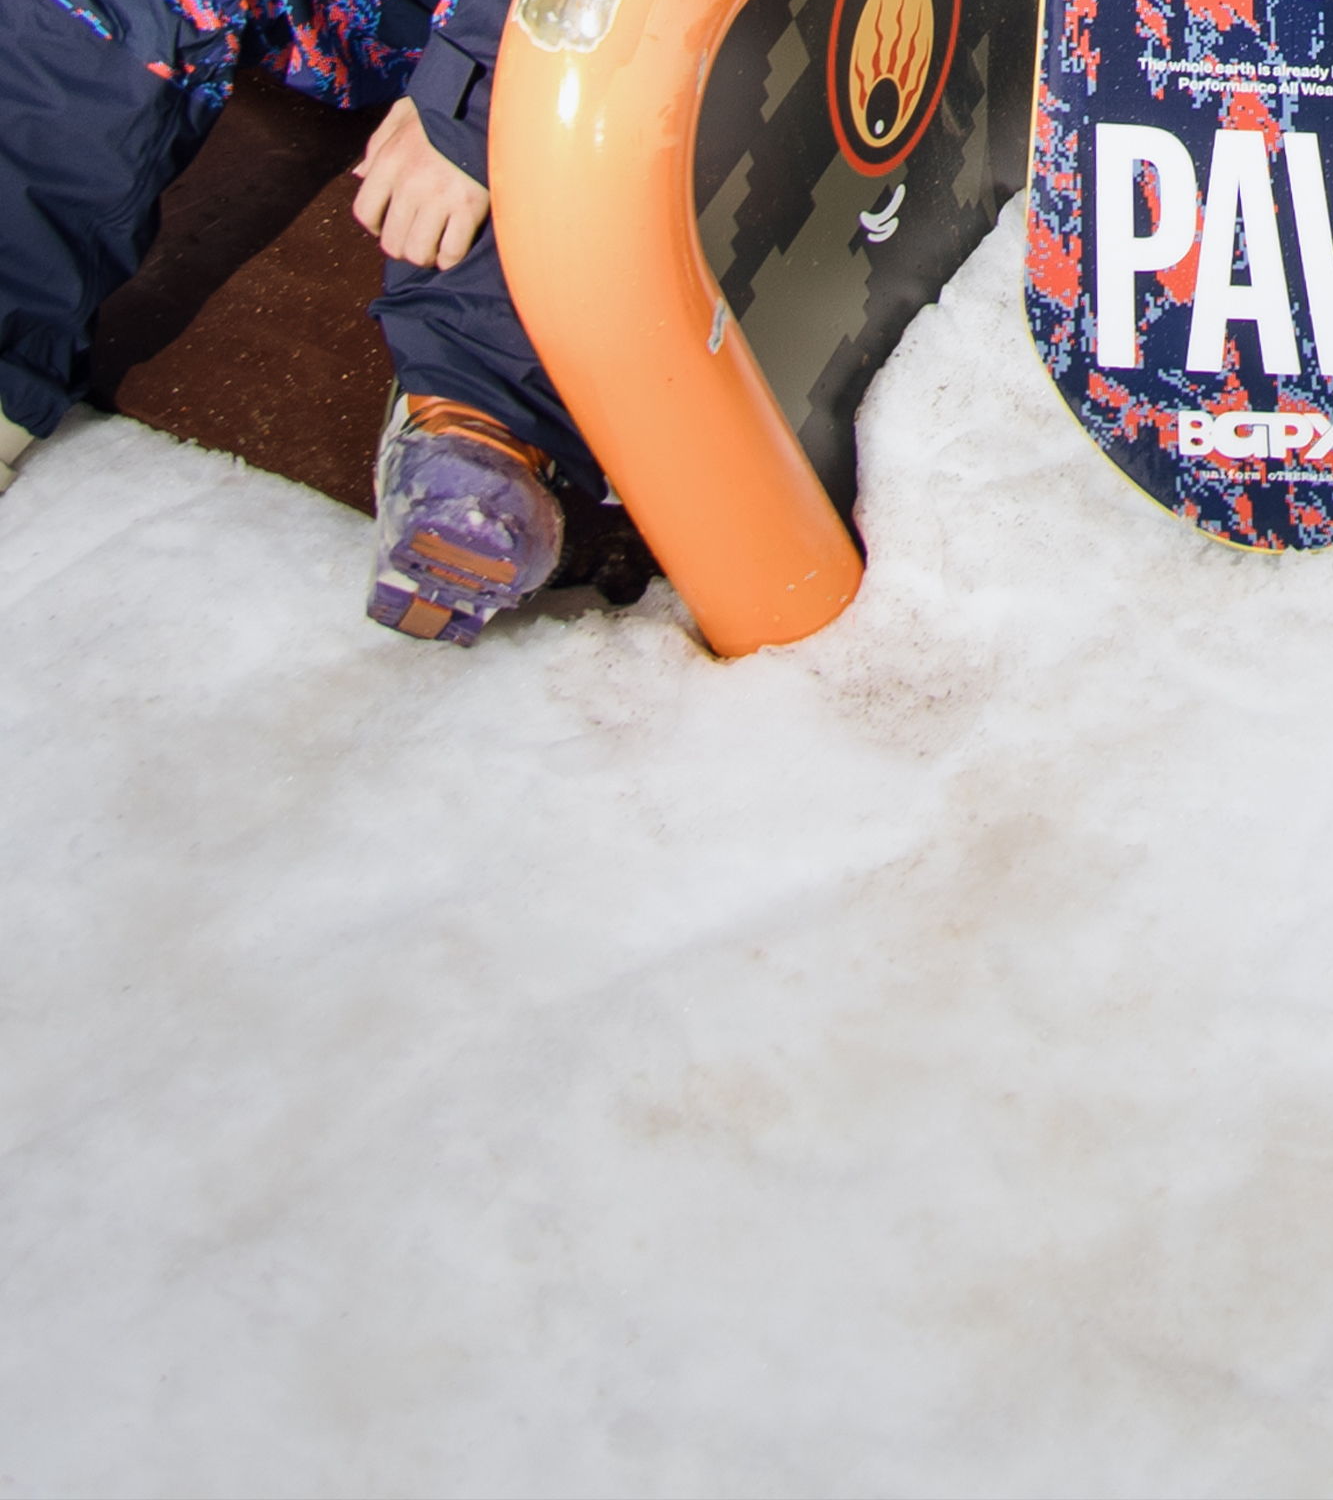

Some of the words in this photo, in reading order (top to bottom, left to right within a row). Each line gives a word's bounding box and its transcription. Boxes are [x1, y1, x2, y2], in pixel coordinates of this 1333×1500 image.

[1138, 57, 1169, 71] The
[1169, 59, 1214, 74] whole
[1215, 61, 1256, 76] earth
[1257, 62, 1271, 77] is
[1272, 63, 1329, 80] already
[1178, 77, 1277, 95] Performance
[1279, 81, 1299, 95] All
[1202, 468, 1262, 482] uniform
